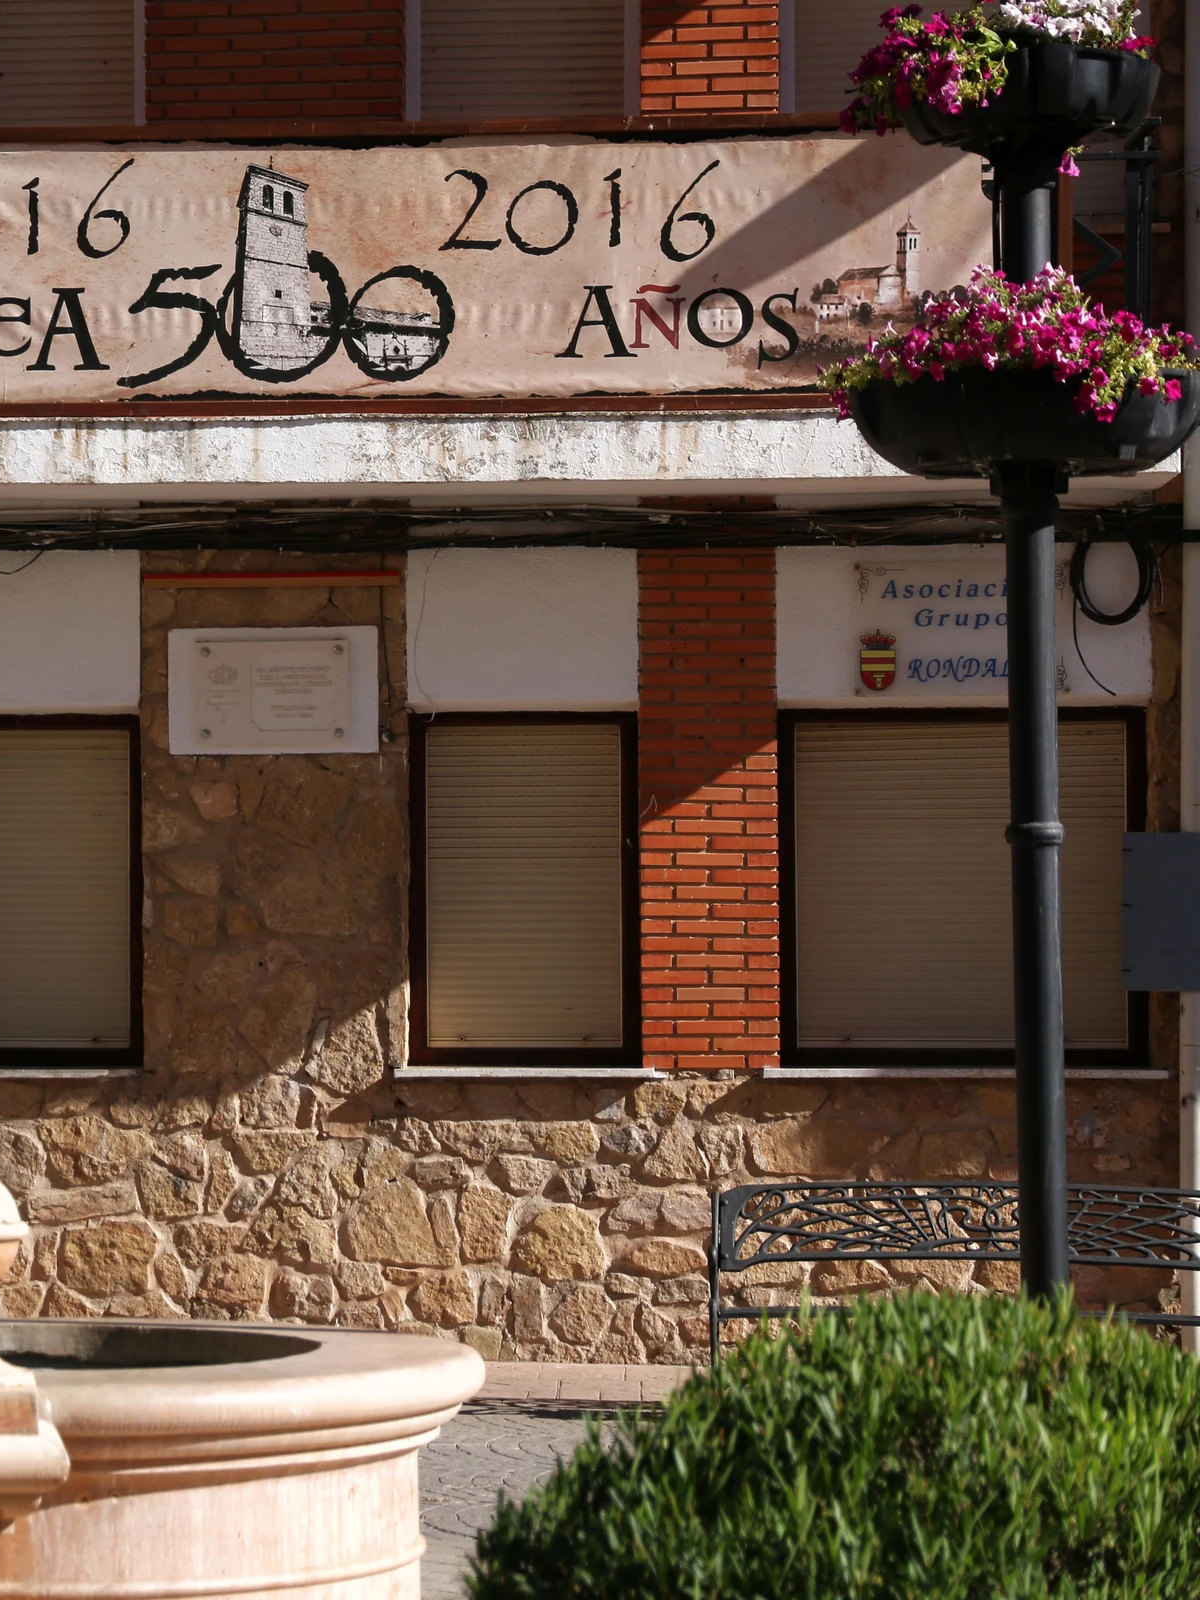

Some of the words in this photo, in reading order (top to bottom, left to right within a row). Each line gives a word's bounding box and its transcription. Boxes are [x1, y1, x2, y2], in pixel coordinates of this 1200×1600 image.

[438, 159, 721, 262] 2016
[116, 248, 456, 388] 500
[554, 283, 800, 370] AÑOS
[914, 608, 1009, 630] Grupo
